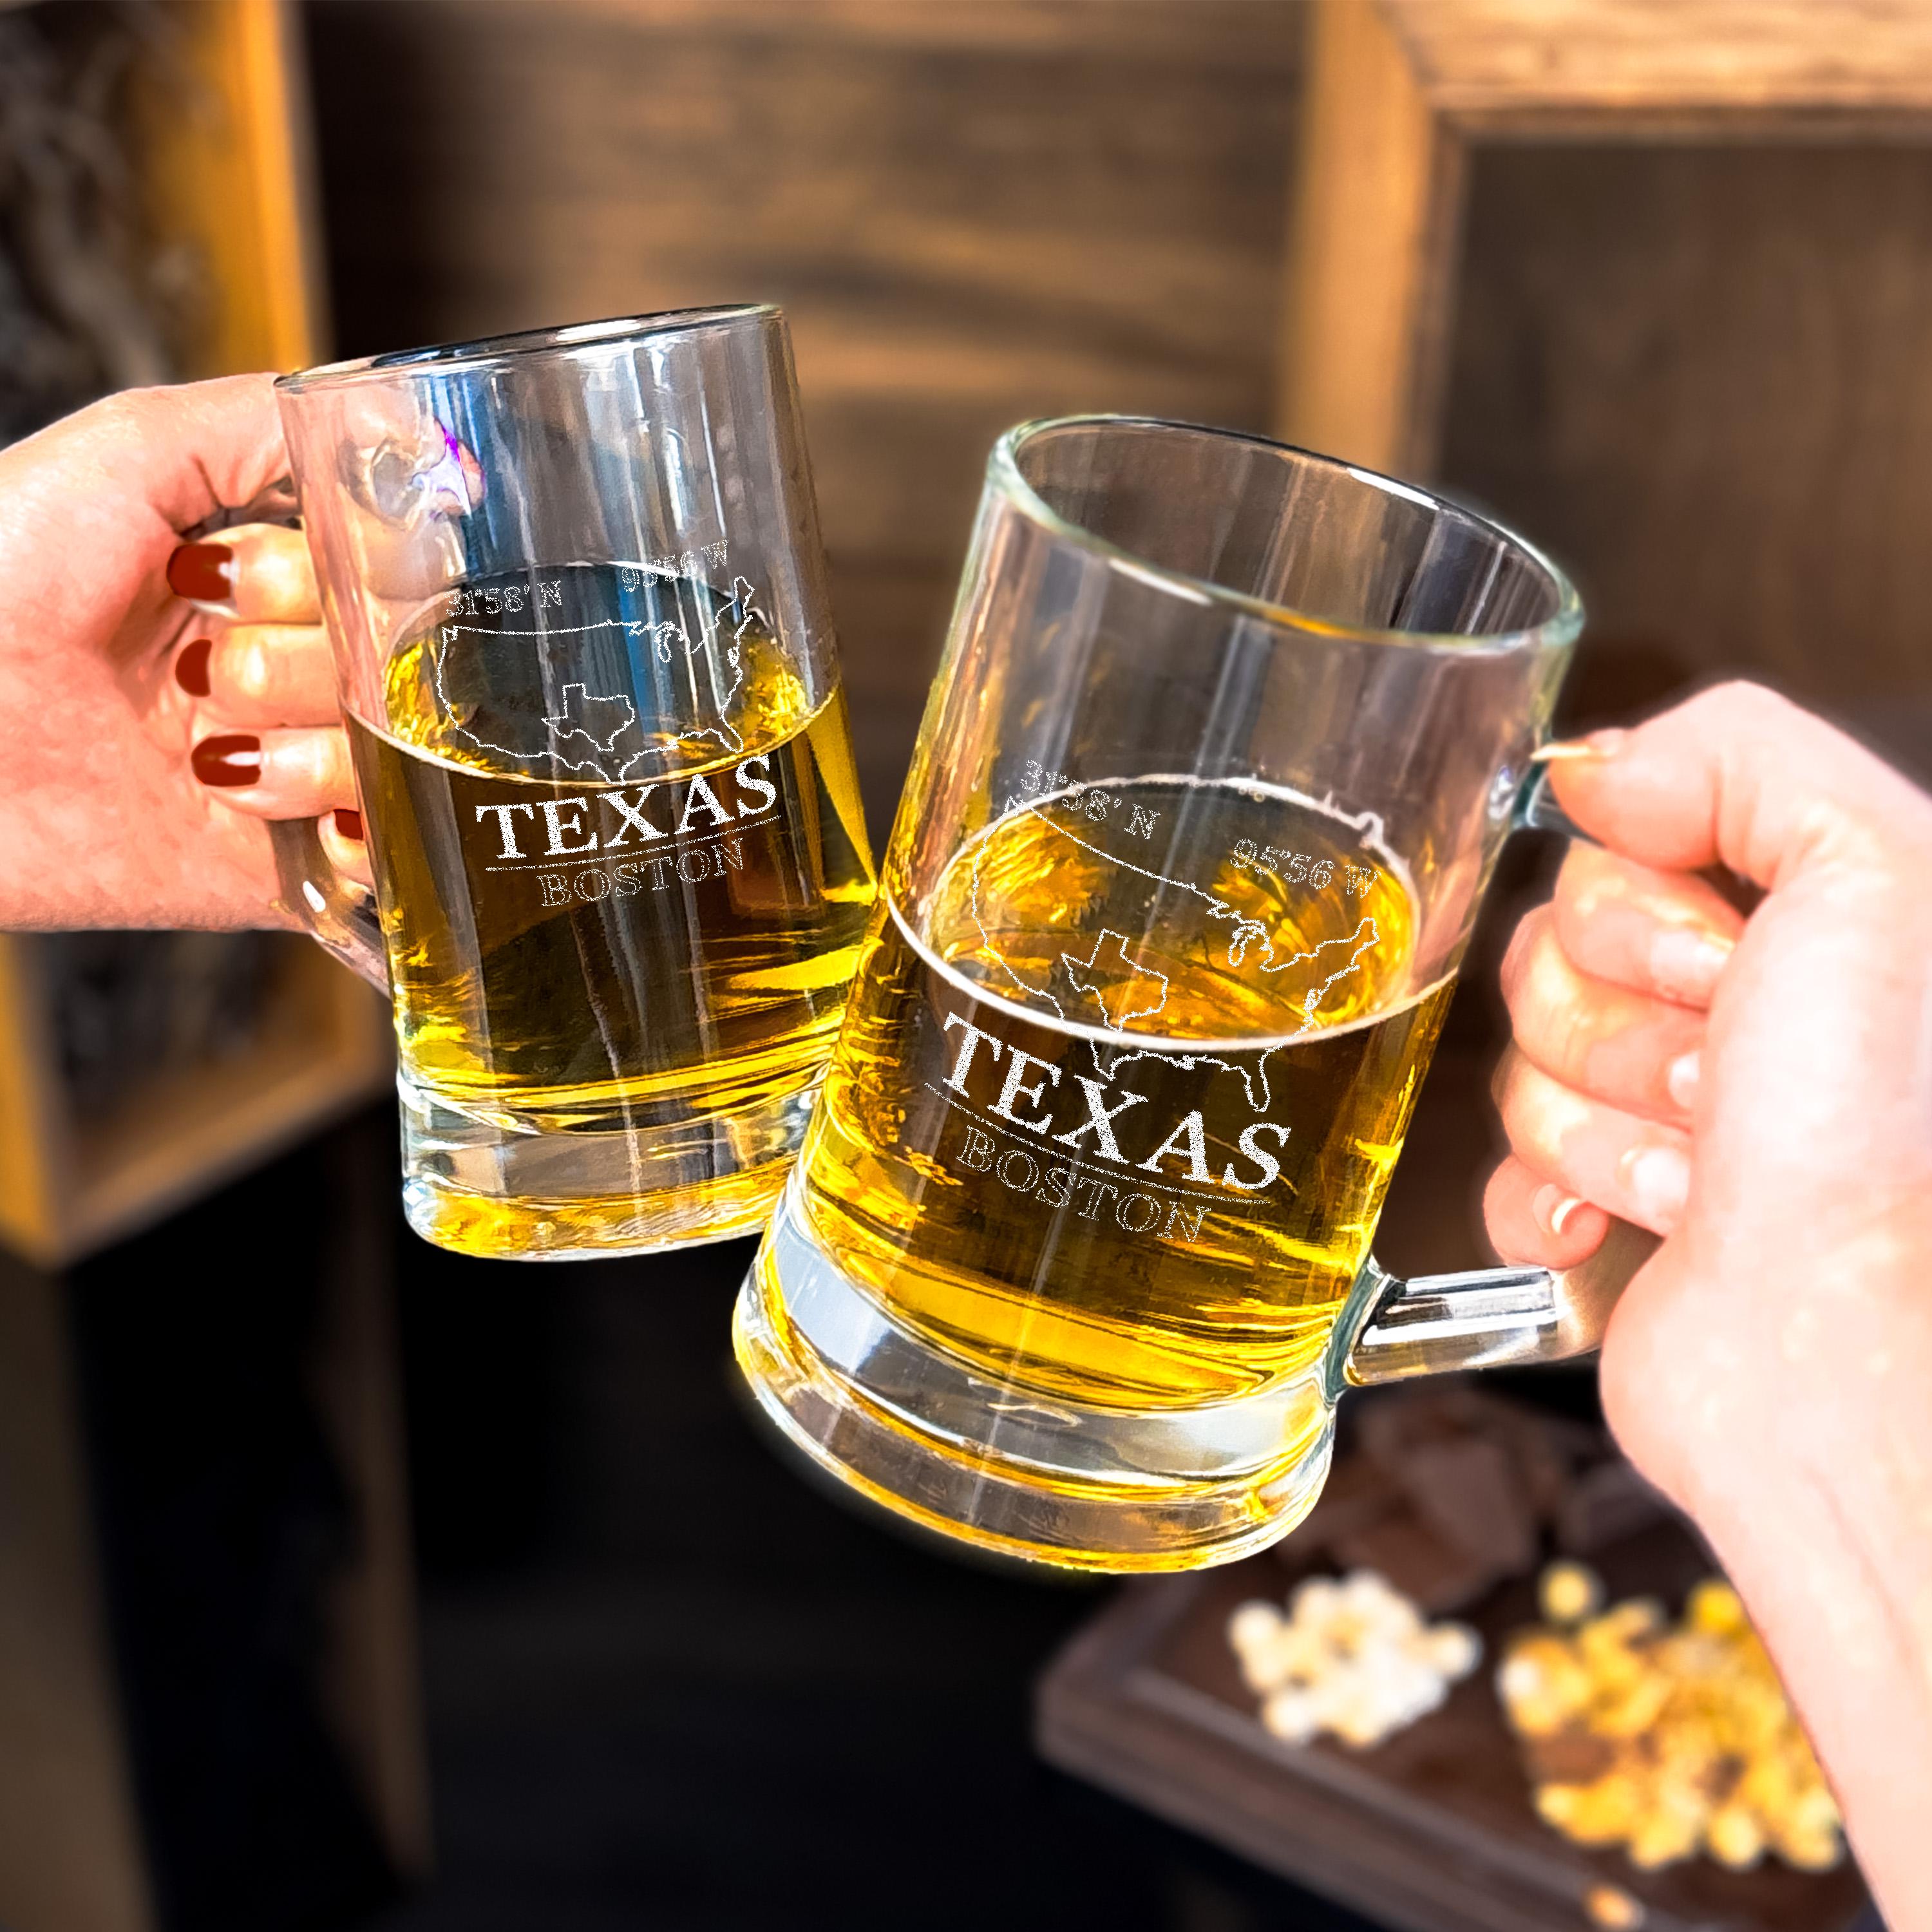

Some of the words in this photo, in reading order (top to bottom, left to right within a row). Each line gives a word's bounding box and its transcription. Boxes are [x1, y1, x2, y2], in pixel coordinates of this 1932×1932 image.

[700, 539, 729, 569] W
[536, 579, 563, 609] N
[475, 754, 777, 860] TEXAS
[1123, 803, 1161, 840] N
[536, 837, 746, 907] BOSTON
[1345, 864, 1382, 899] W
[942, 1011, 1292, 1191] TEXAS
[955, 1124, 1212, 1243] BOSTON
